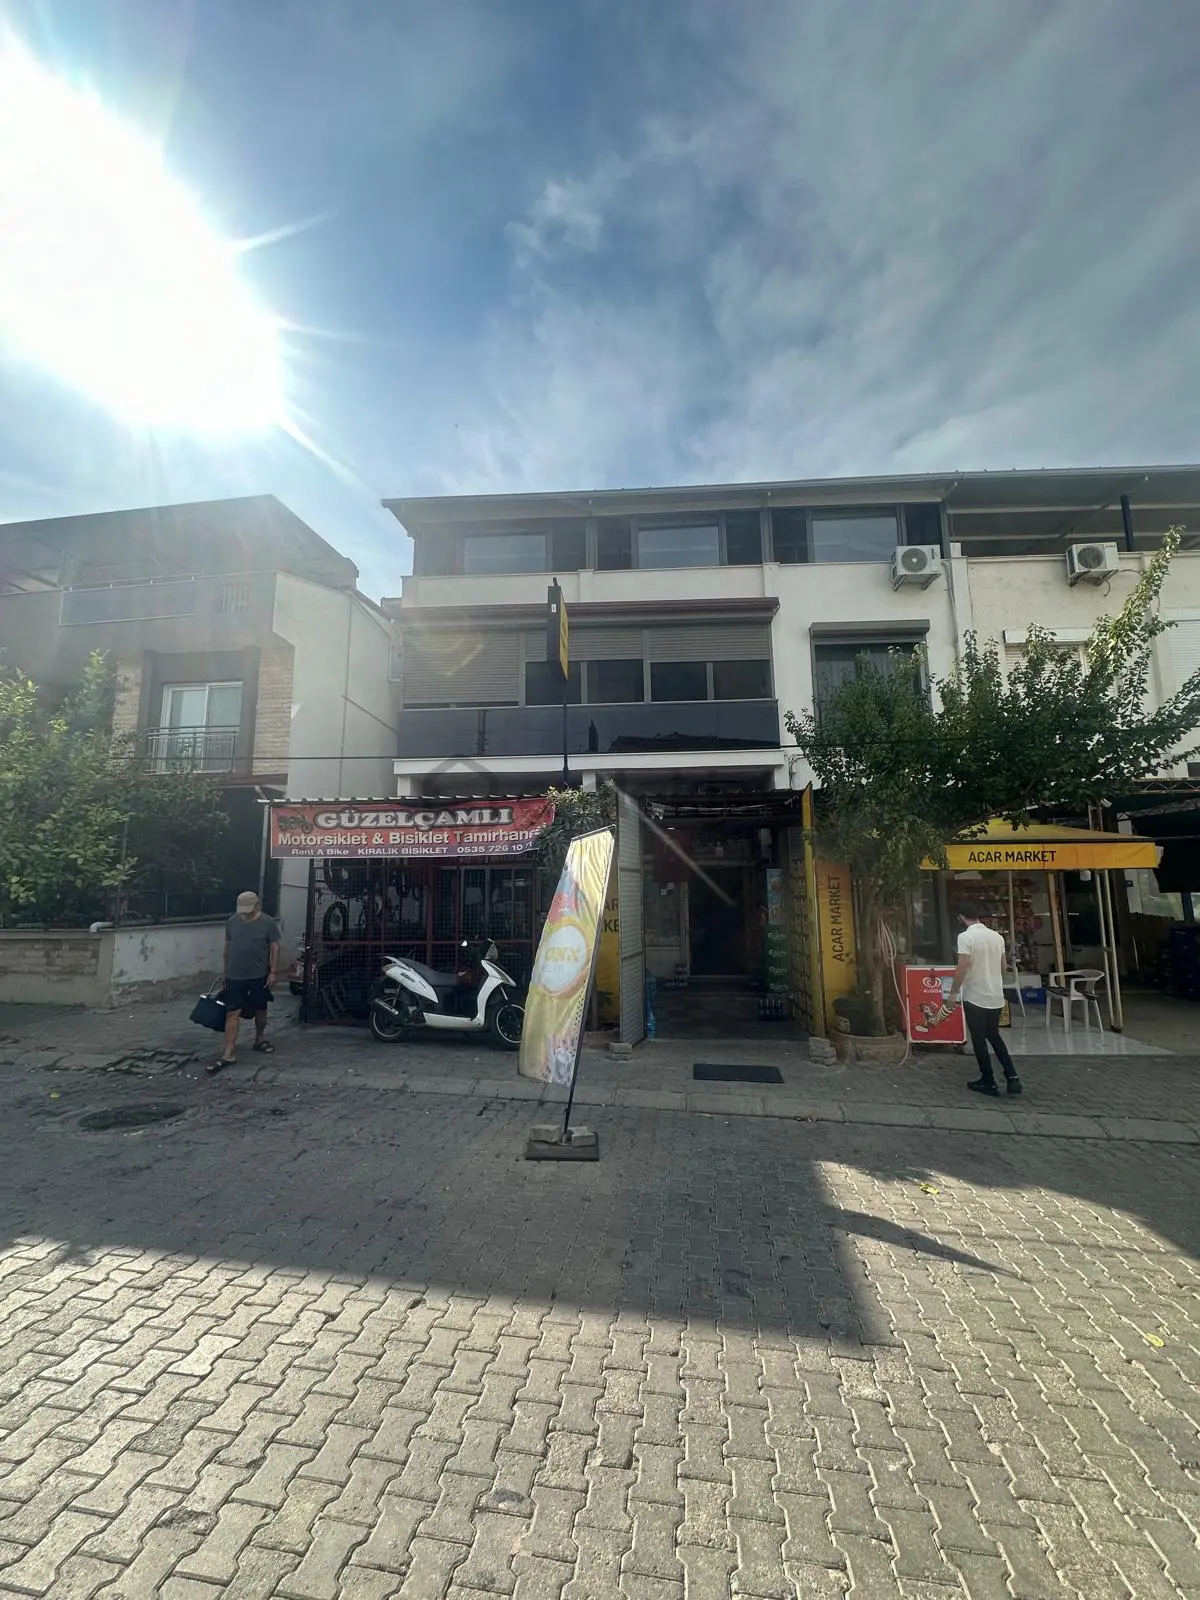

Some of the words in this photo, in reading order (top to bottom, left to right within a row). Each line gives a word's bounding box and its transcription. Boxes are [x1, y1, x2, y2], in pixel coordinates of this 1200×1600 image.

[315, 807, 512, 830] GÜZELÇAMLI
[278, 832, 368, 846] Motorsiklet
[371, 831, 385, 845] &
[389, 831, 449, 845] Bisiklet
[291, 848, 314, 856] Rent
[316, 848, 324, 856] A
[326, 848, 350, 856] Bike
[457, 845, 485, 854] 0535
[511, 843, 523, 852] 10
[968, 851, 1002, 863] ACAR
[1004, 850, 1057, 862] MARKET
[828, 874, 841, 925] MARKET
[830, 927, 844, 962] ACAR
